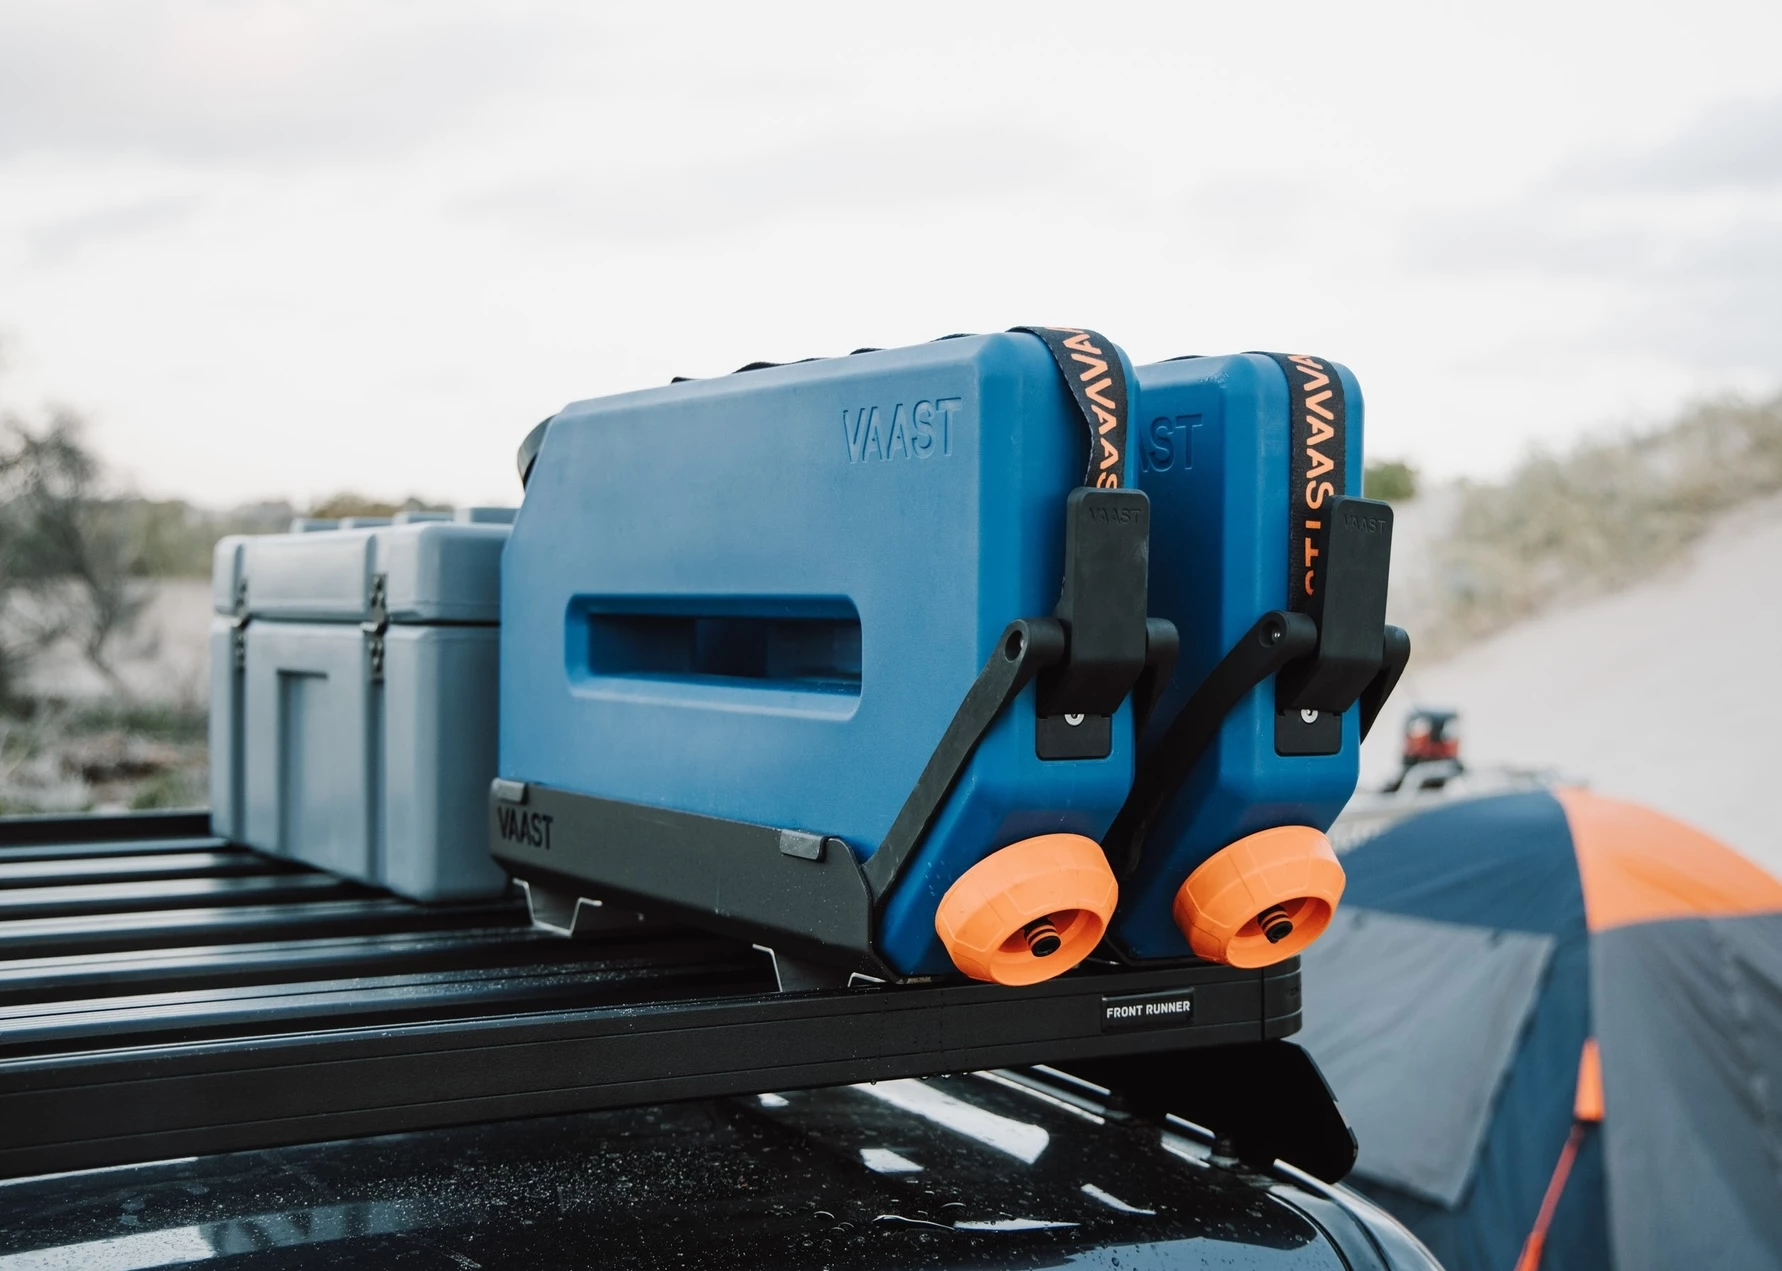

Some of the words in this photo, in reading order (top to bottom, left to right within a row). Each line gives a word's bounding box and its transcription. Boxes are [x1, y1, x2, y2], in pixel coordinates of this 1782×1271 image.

[843, 396, 962, 464] VAAST
[1088, 506, 1142, 525] VAAST
[1343, 513, 1387, 533] VAAST
[497, 805, 554, 851] VAAST
[1106, 1004, 1144, 1019] FRONT
[1146, 1000, 1191, 1015] RUNNER
